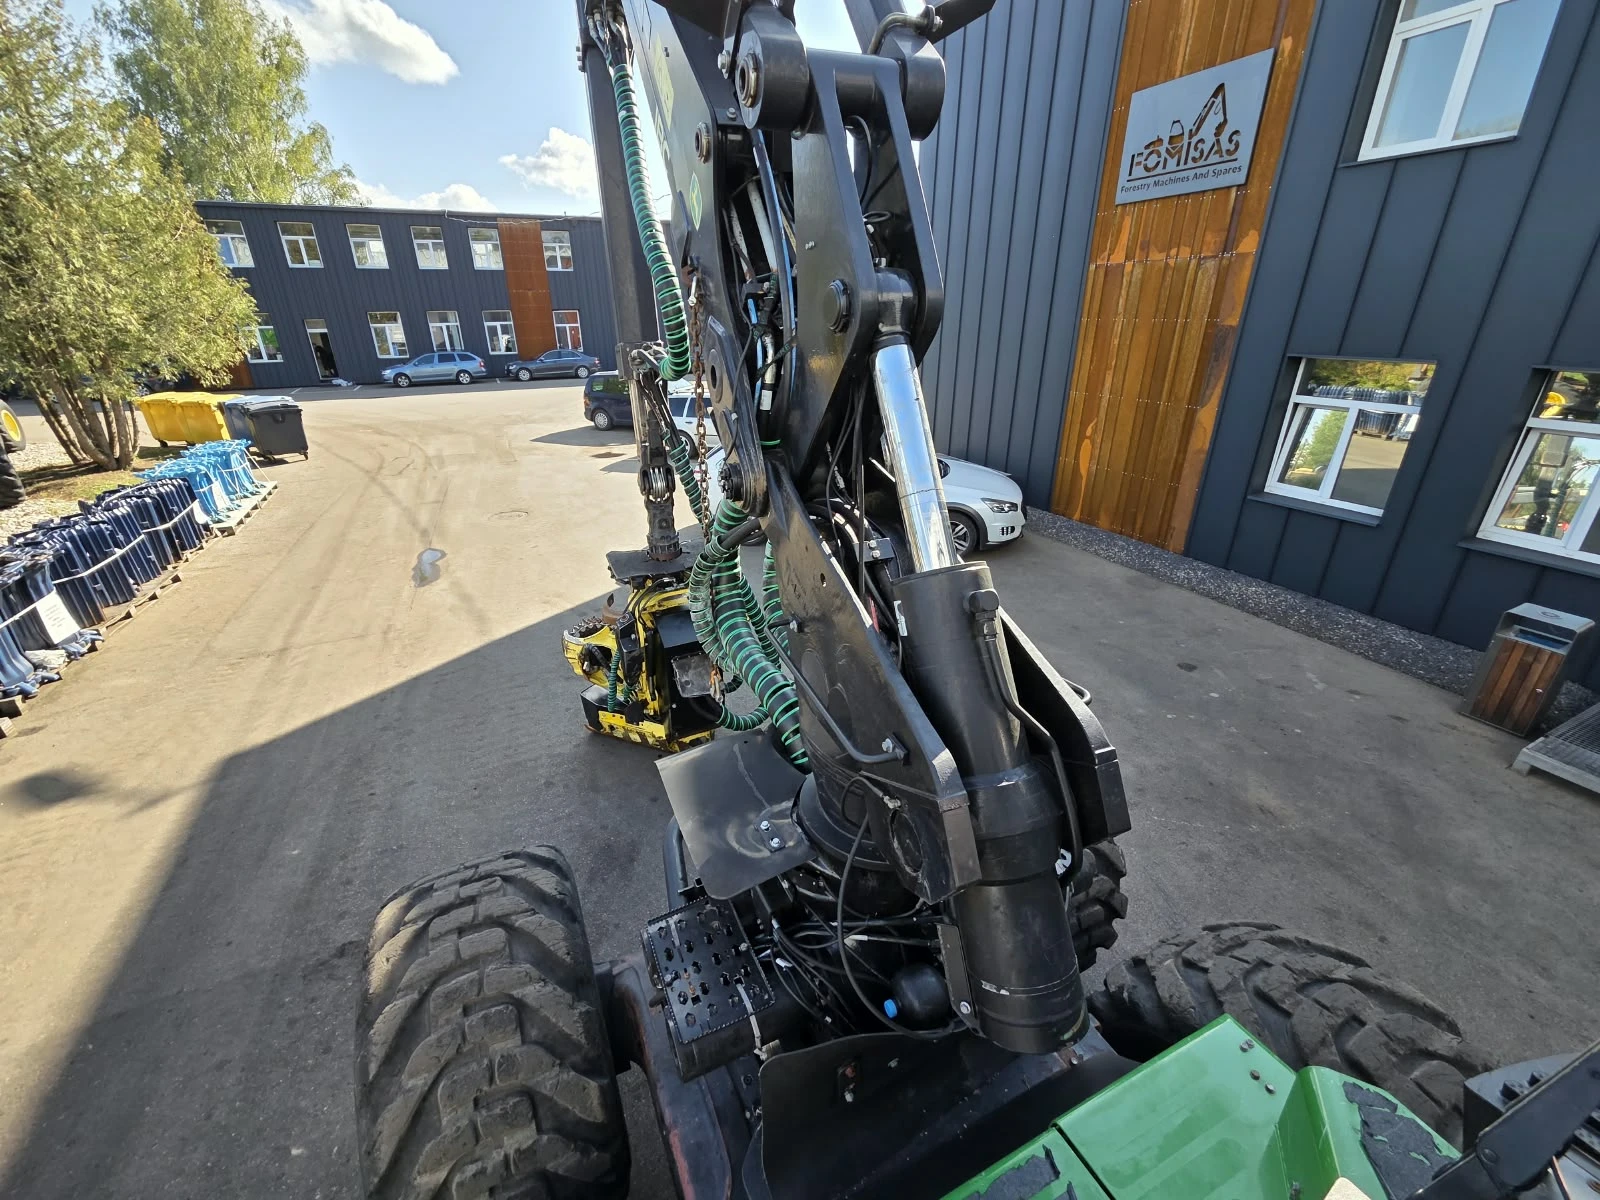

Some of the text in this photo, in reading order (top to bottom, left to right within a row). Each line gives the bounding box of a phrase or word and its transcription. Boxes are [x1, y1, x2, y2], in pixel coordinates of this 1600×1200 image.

[1128, 129, 1241, 177] FOMISAS
[1120, 165, 1242, 194] Forestry Machines And Spares
